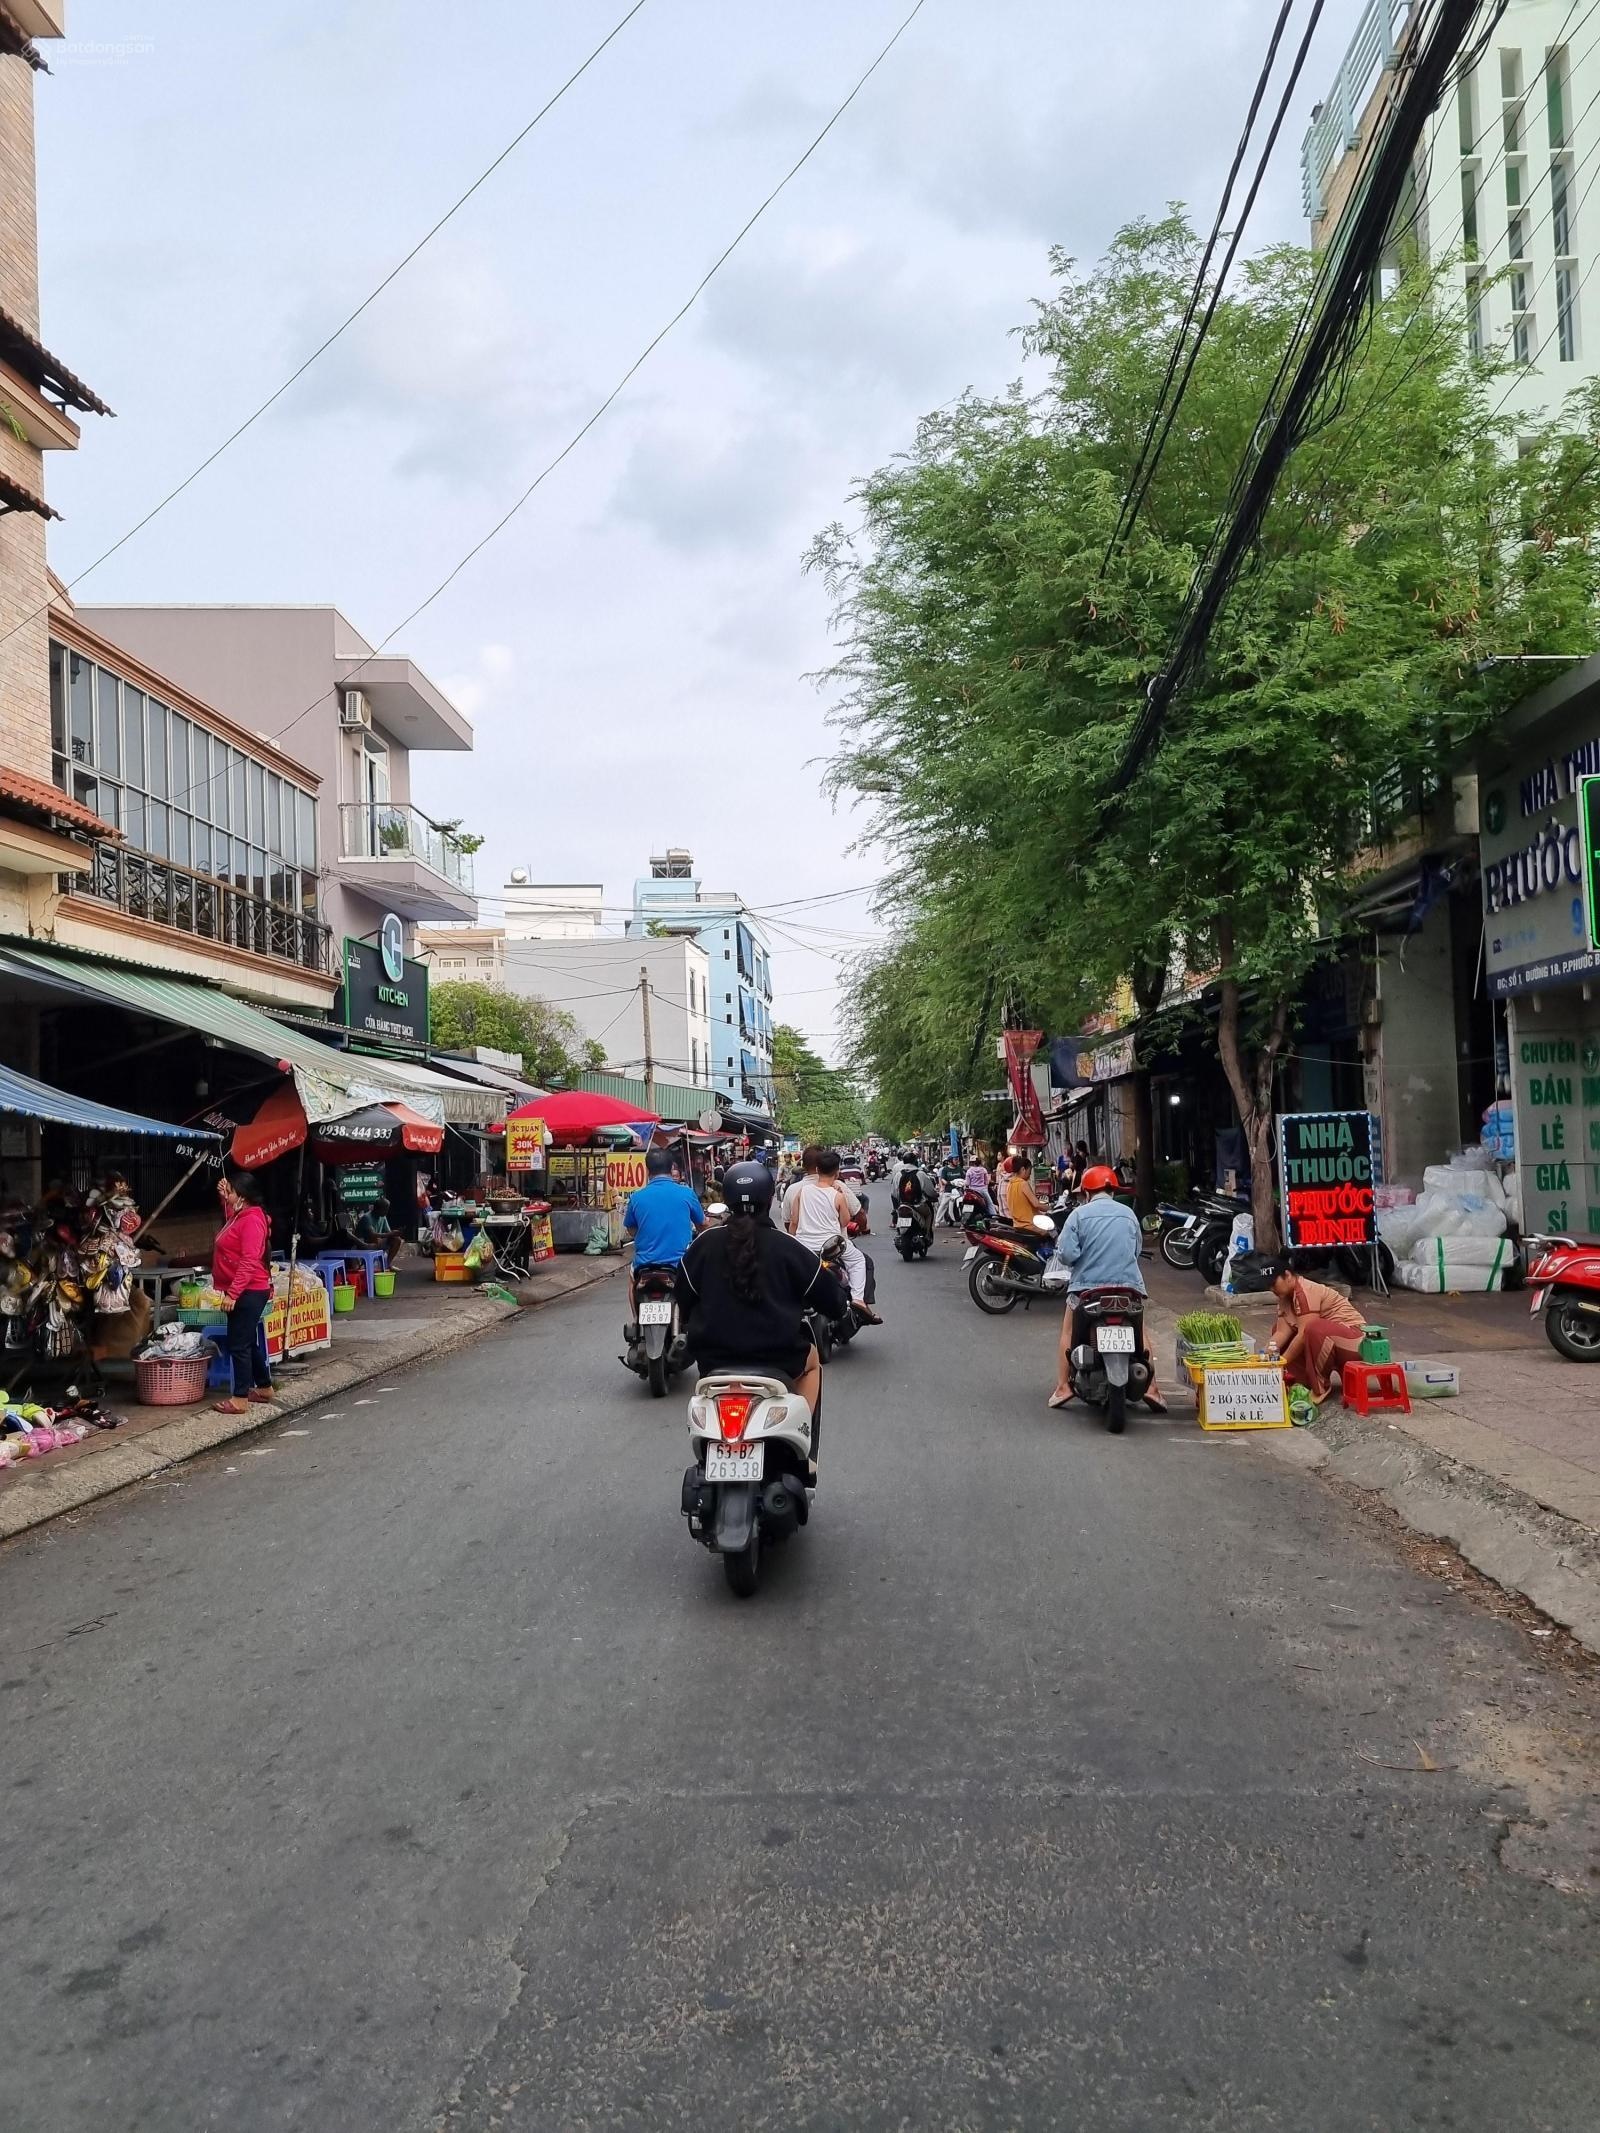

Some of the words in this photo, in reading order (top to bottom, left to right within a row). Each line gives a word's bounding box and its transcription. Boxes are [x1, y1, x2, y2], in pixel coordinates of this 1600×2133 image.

[1520, 757, 1563, 817] NHÀ
[1486, 815, 1581, 913] PHƯỚC
[378, 985, 408, 1007] KITCHEN
[376, 1018, 390, 1032] HÀNG
[1521, 1040, 1575, 1065] CHUYÊN
[1529, 1073, 1572, 1105] BÁN
[319, 1124, 349, 1137] 0938.
[352, 1126, 371, 1139] 444
[373, 1127, 393, 1139] 333
[516, 1140, 533, 1149] 30K
[1298, 1117, 1354, 1150] NHÀ
[1541, 1114, 1565, 1150] LẺ
[607, 1155, 645, 1187] CHÁO
[1288, 1147, 1370, 1184] THUỐC
[1536, 1160, 1571, 1191] GIÁ
[1288, 1182, 1374, 1216] PHƯỚC
[1299, 1212, 1367, 1244] BÌNH
[1547, 1201, 1567, 1233] SỈ
[1207, 1372, 1226, 1386] MĂNG
[1227, 1371, 1241, 1386] TÂY
[1241, 1373, 1257, 1386] NINH
[1258, 1370, 1280, 1388] THUẬN
[1210, 1394, 1216, 1404] 2
[1218, 1391, 1233, 1404] BÓ
[1235, 1394, 1248, 1404] 35
[1250, 1391, 1279, 1404] NGÀN
[1226, 1407, 1237, 1421] SỈ
[1239, 1412, 1246, 1421] &
[1250, 1407, 1264, 1421] LẺ
[717, 1444, 755, 1459] 63-B2
[709, 1462, 760, 1478] 263.38
